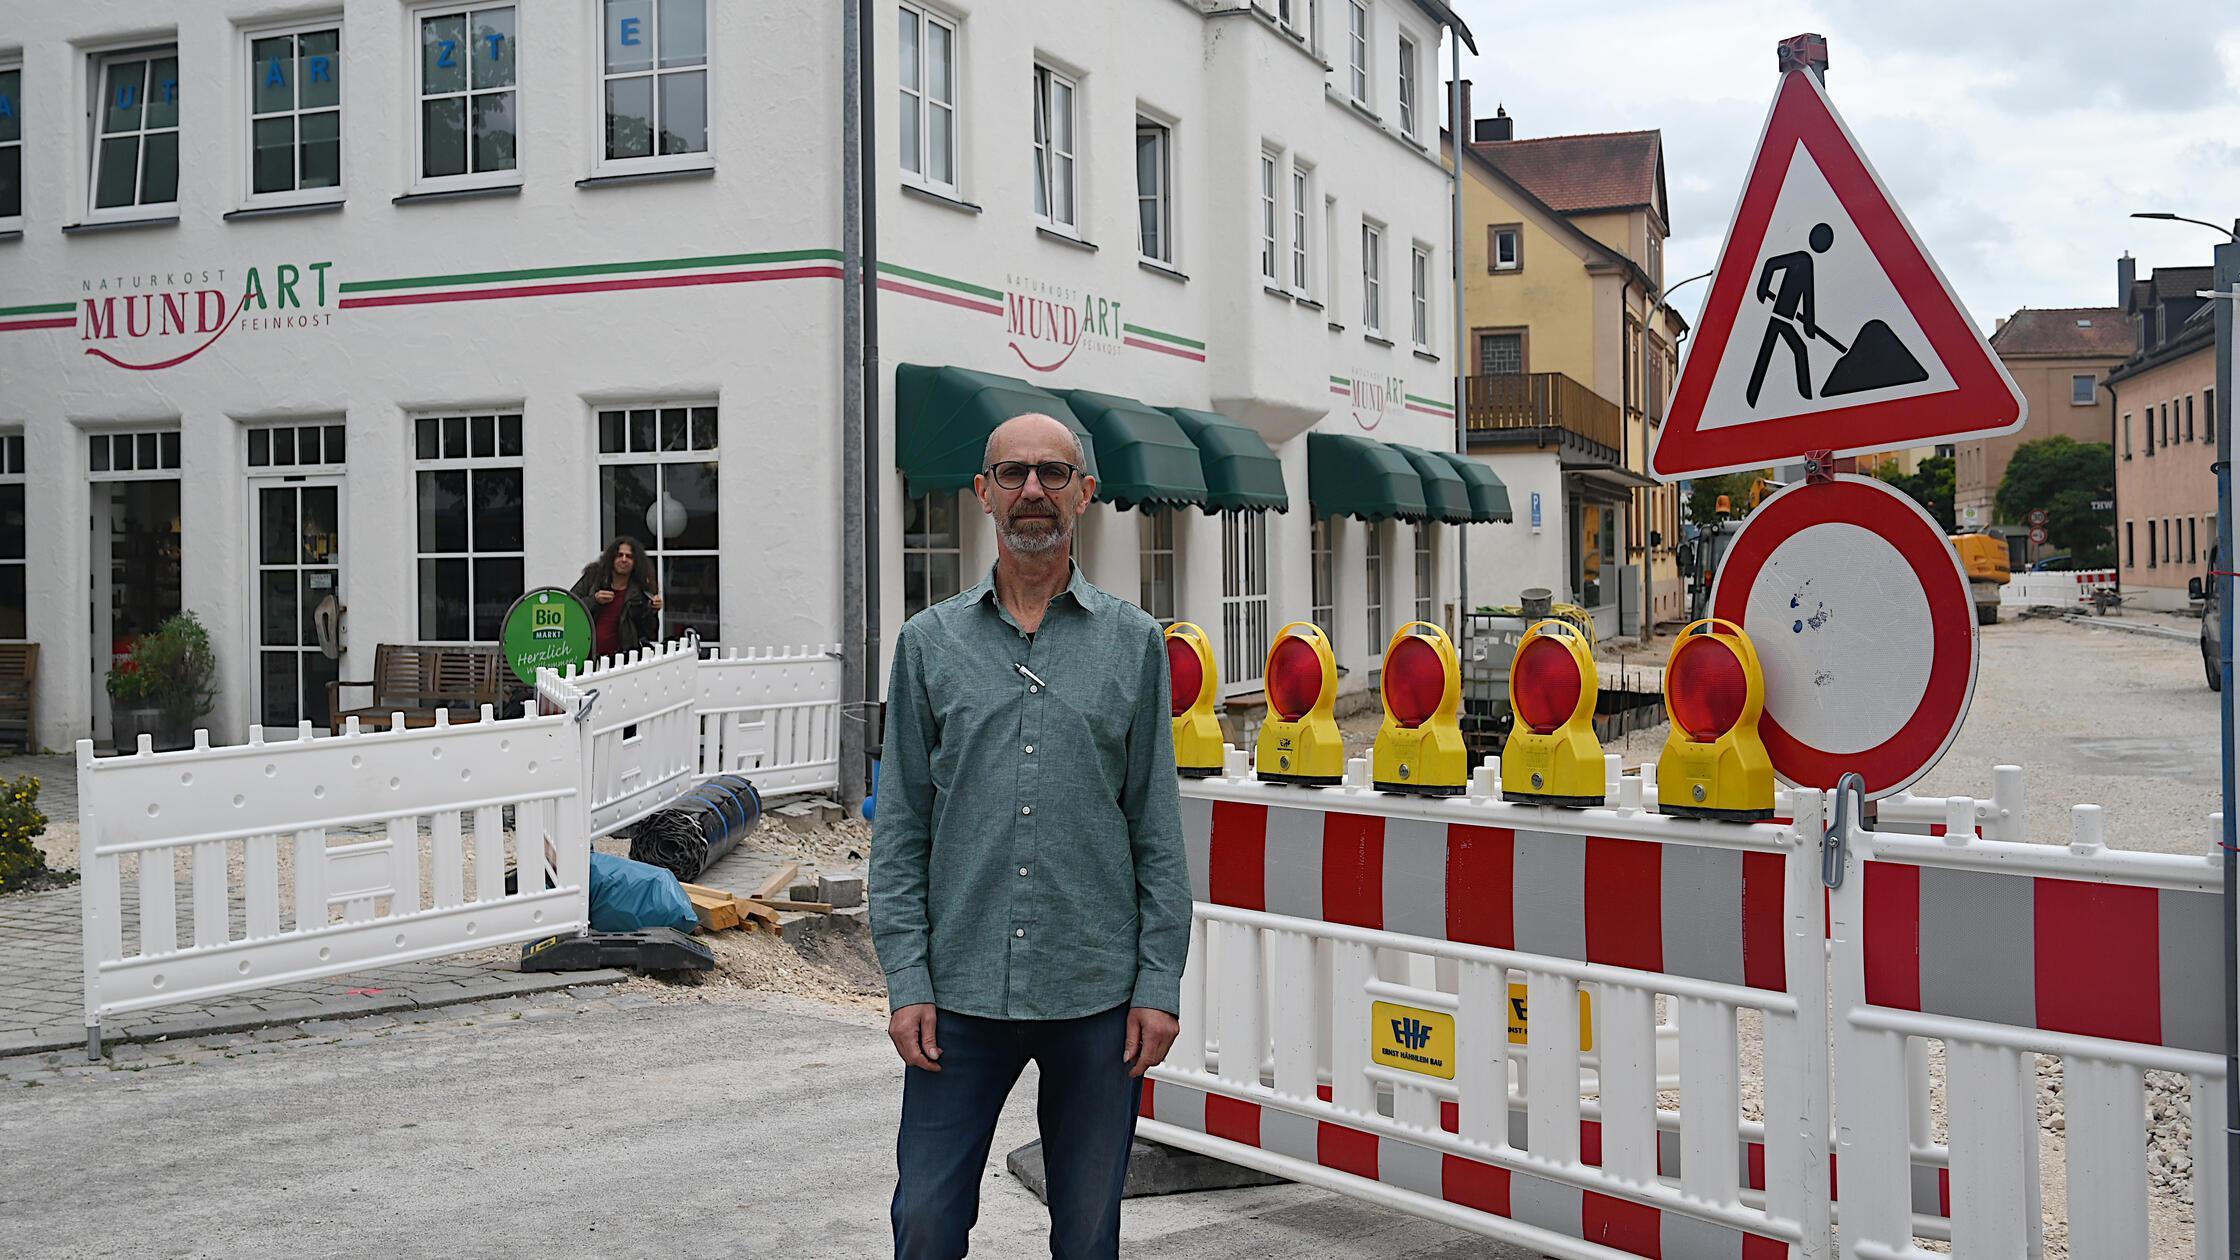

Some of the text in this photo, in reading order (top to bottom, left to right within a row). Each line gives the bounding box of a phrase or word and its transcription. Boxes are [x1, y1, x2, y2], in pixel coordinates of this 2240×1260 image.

[82, 269, 225, 291] NATURKOST
[241, 313, 332, 331] FEINKOST
[2090, 501, 2114, 510] THW
[536, 610, 561, 625] Bio
[535, 631, 561, 639] MARKT
[517, 641, 572, 667] Herzlich
[1391, 1017, 1433, 1050] EHF
[1381, 1047, 1399, 1057] ERNST
[1429, 1057, 1443, 1067] BAU
